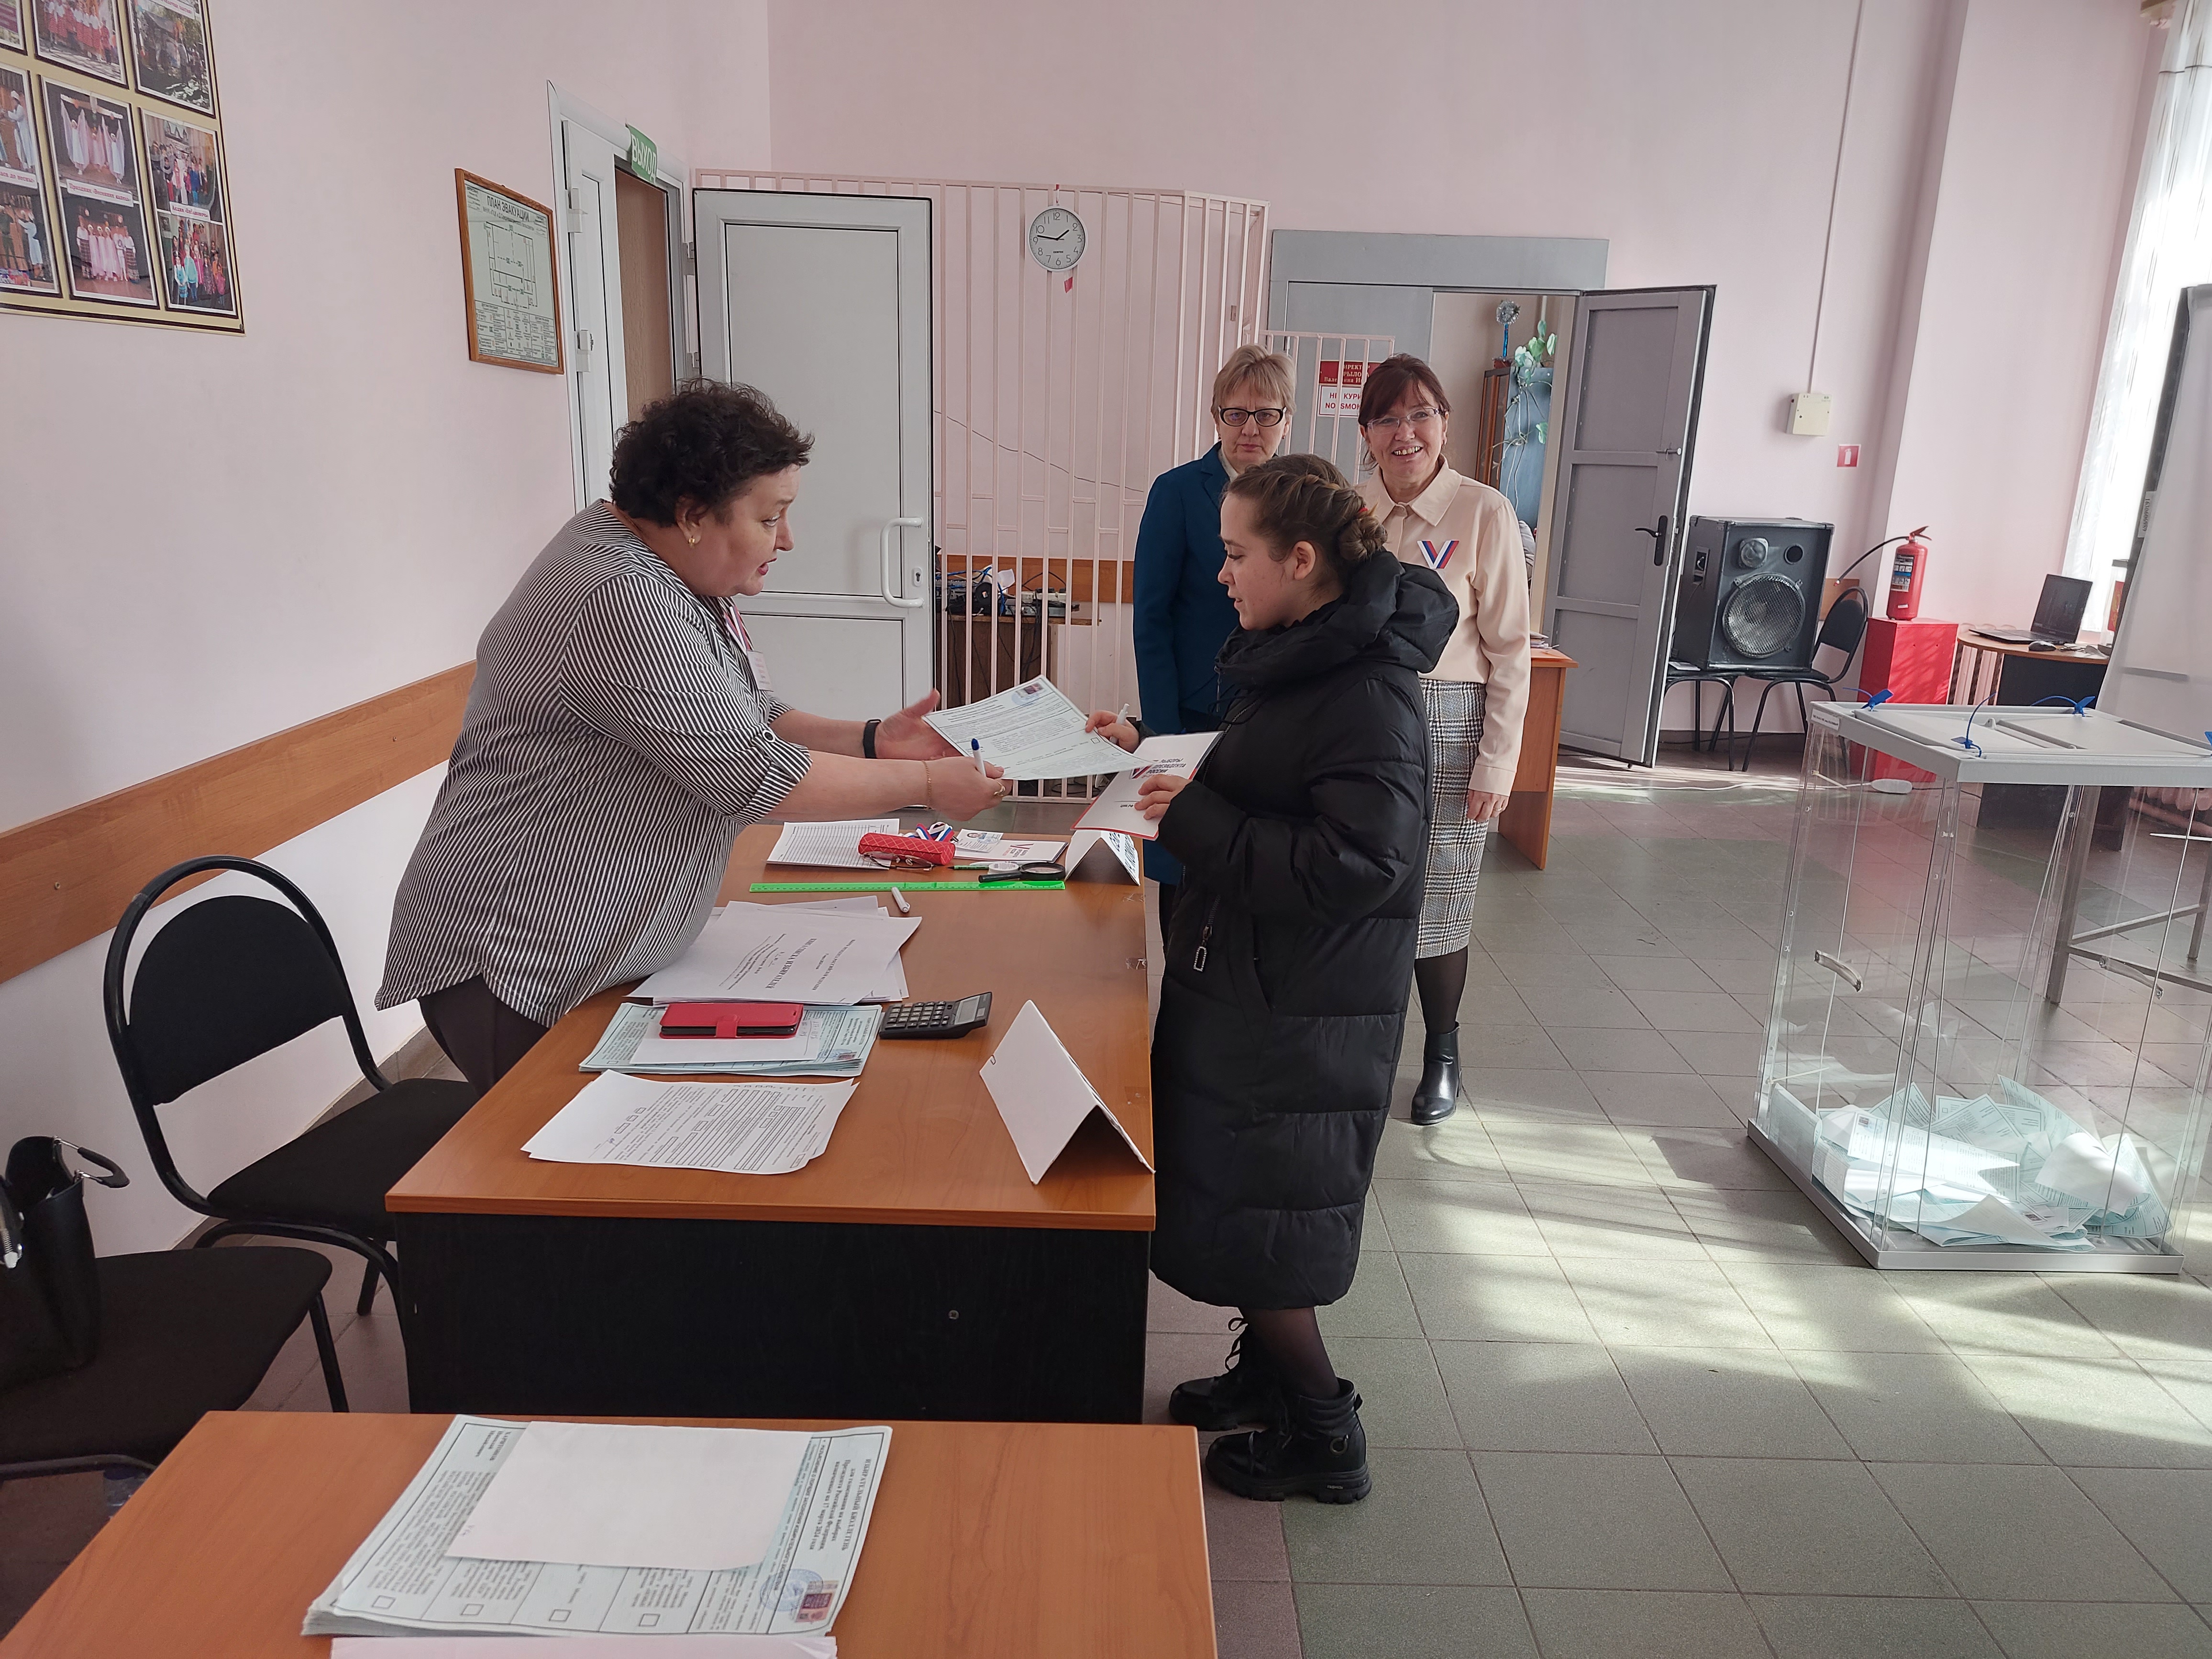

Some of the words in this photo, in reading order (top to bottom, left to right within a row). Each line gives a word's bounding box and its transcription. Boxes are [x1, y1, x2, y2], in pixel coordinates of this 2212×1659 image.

[631, 133, 657, 185] ВЫХОД
[487, 196, 501, 211] ПЛАН
[502, 201, 530, 223] ЭВАКУАЦИИ
[1044, 216, 1050, 224] 11
[1053, 212, 1061, 221] 12
[1036, 225, 1045, 234] 10
[1072, 222, 1078, 232] 2
[1032, 236, 1039, 245] 9
[1077, 234, 1083, 243] 3
[1037, 247, 1044, 256] 8
[1073, 246, 1079, 254] 4
[1046, 255, 1051, 264] 7
[1055, 257, 1062, 266] 6
[1066, 254, 1072, 263] 5
[765, 960, 794, 989] ИЗБИРАТЕЛЕЙ
[838, 1459, 851, 1489] Президента
[854, 1459, 872, 1510] ИЗБИРАТЕЛЬНЫЙ
[829, 1490, 840, 1519] Российской
[813, 1526, 822, 1537] 2024
[832, 1519, 842, 1541] выборах
[842, 1512, 858, 1550] БЮЛЛЕТЕНЬ
